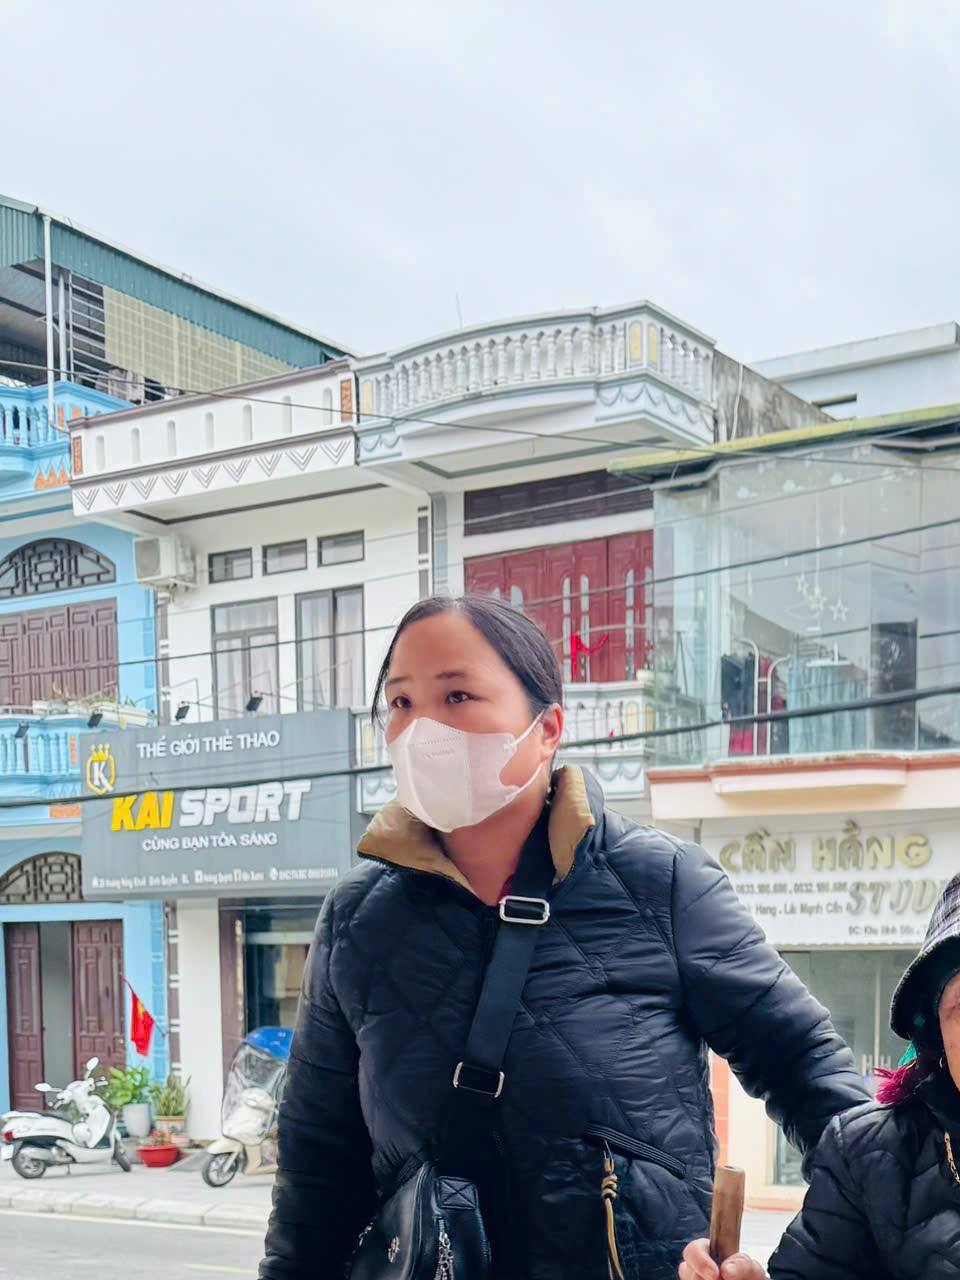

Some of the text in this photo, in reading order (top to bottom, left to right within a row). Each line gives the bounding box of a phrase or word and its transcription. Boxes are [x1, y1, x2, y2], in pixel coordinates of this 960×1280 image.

[136, 728, 280, 758] THẾ GIỚI THỂ THAO
[111, 780, 312, 832] KAI SPORT
[142, 835, 179, 851] CÙNG
[181, 835, 209, 852] BẠN
[239, 829, 278, 846] SÁNG
